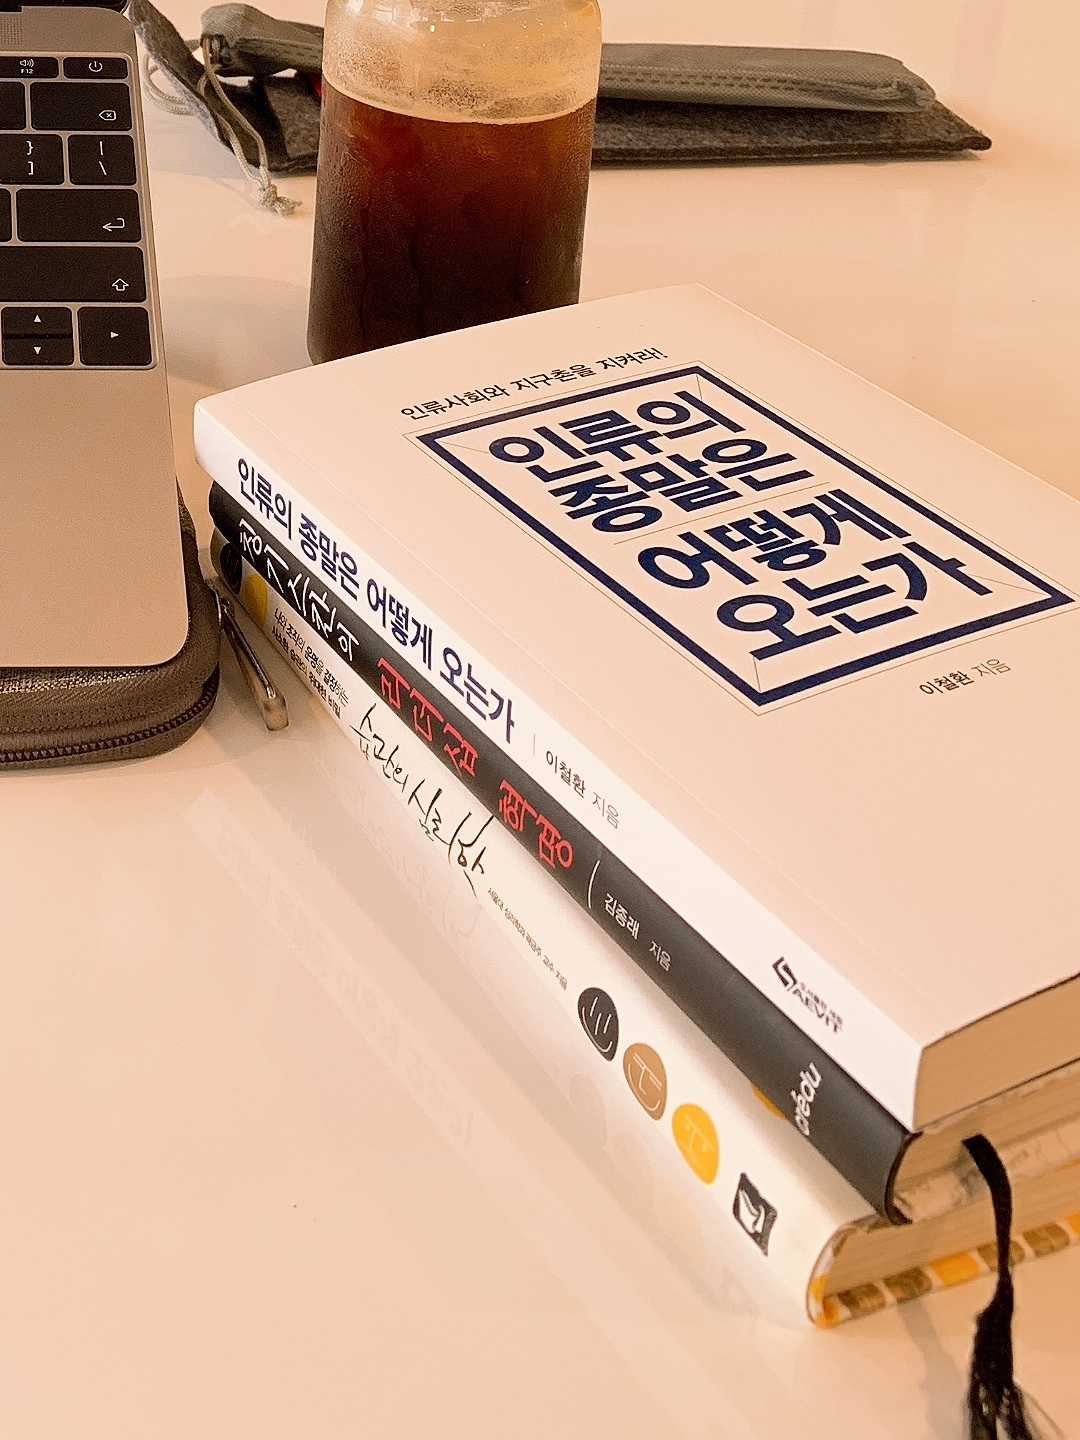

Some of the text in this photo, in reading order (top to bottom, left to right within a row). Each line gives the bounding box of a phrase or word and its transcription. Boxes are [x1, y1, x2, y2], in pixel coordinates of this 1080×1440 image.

[400, 346, 669, 422] 인류사회와 지구촌을 지켜라!
[488, 389, 747, 485] 인류의
[548, 438, 815, 534] 종말은
[638, 487, 913, 590] 어떻게
[237, 457, 517, 744] 인류의 종말은 어떻게 오는가
[716, 542, 995, 661] 오는가
[274, 607, 350, 708] 나와 조직의 운명을 결정하는
[917, 657, 1013, 699] 이철환 지음
[377, 657, 480, 778] 리더십
[545, 749, 621, 830] 이철환 지음
[407, 778, 496, 900] 심리학
[603, 891, 672, 972] 김종래 지음
